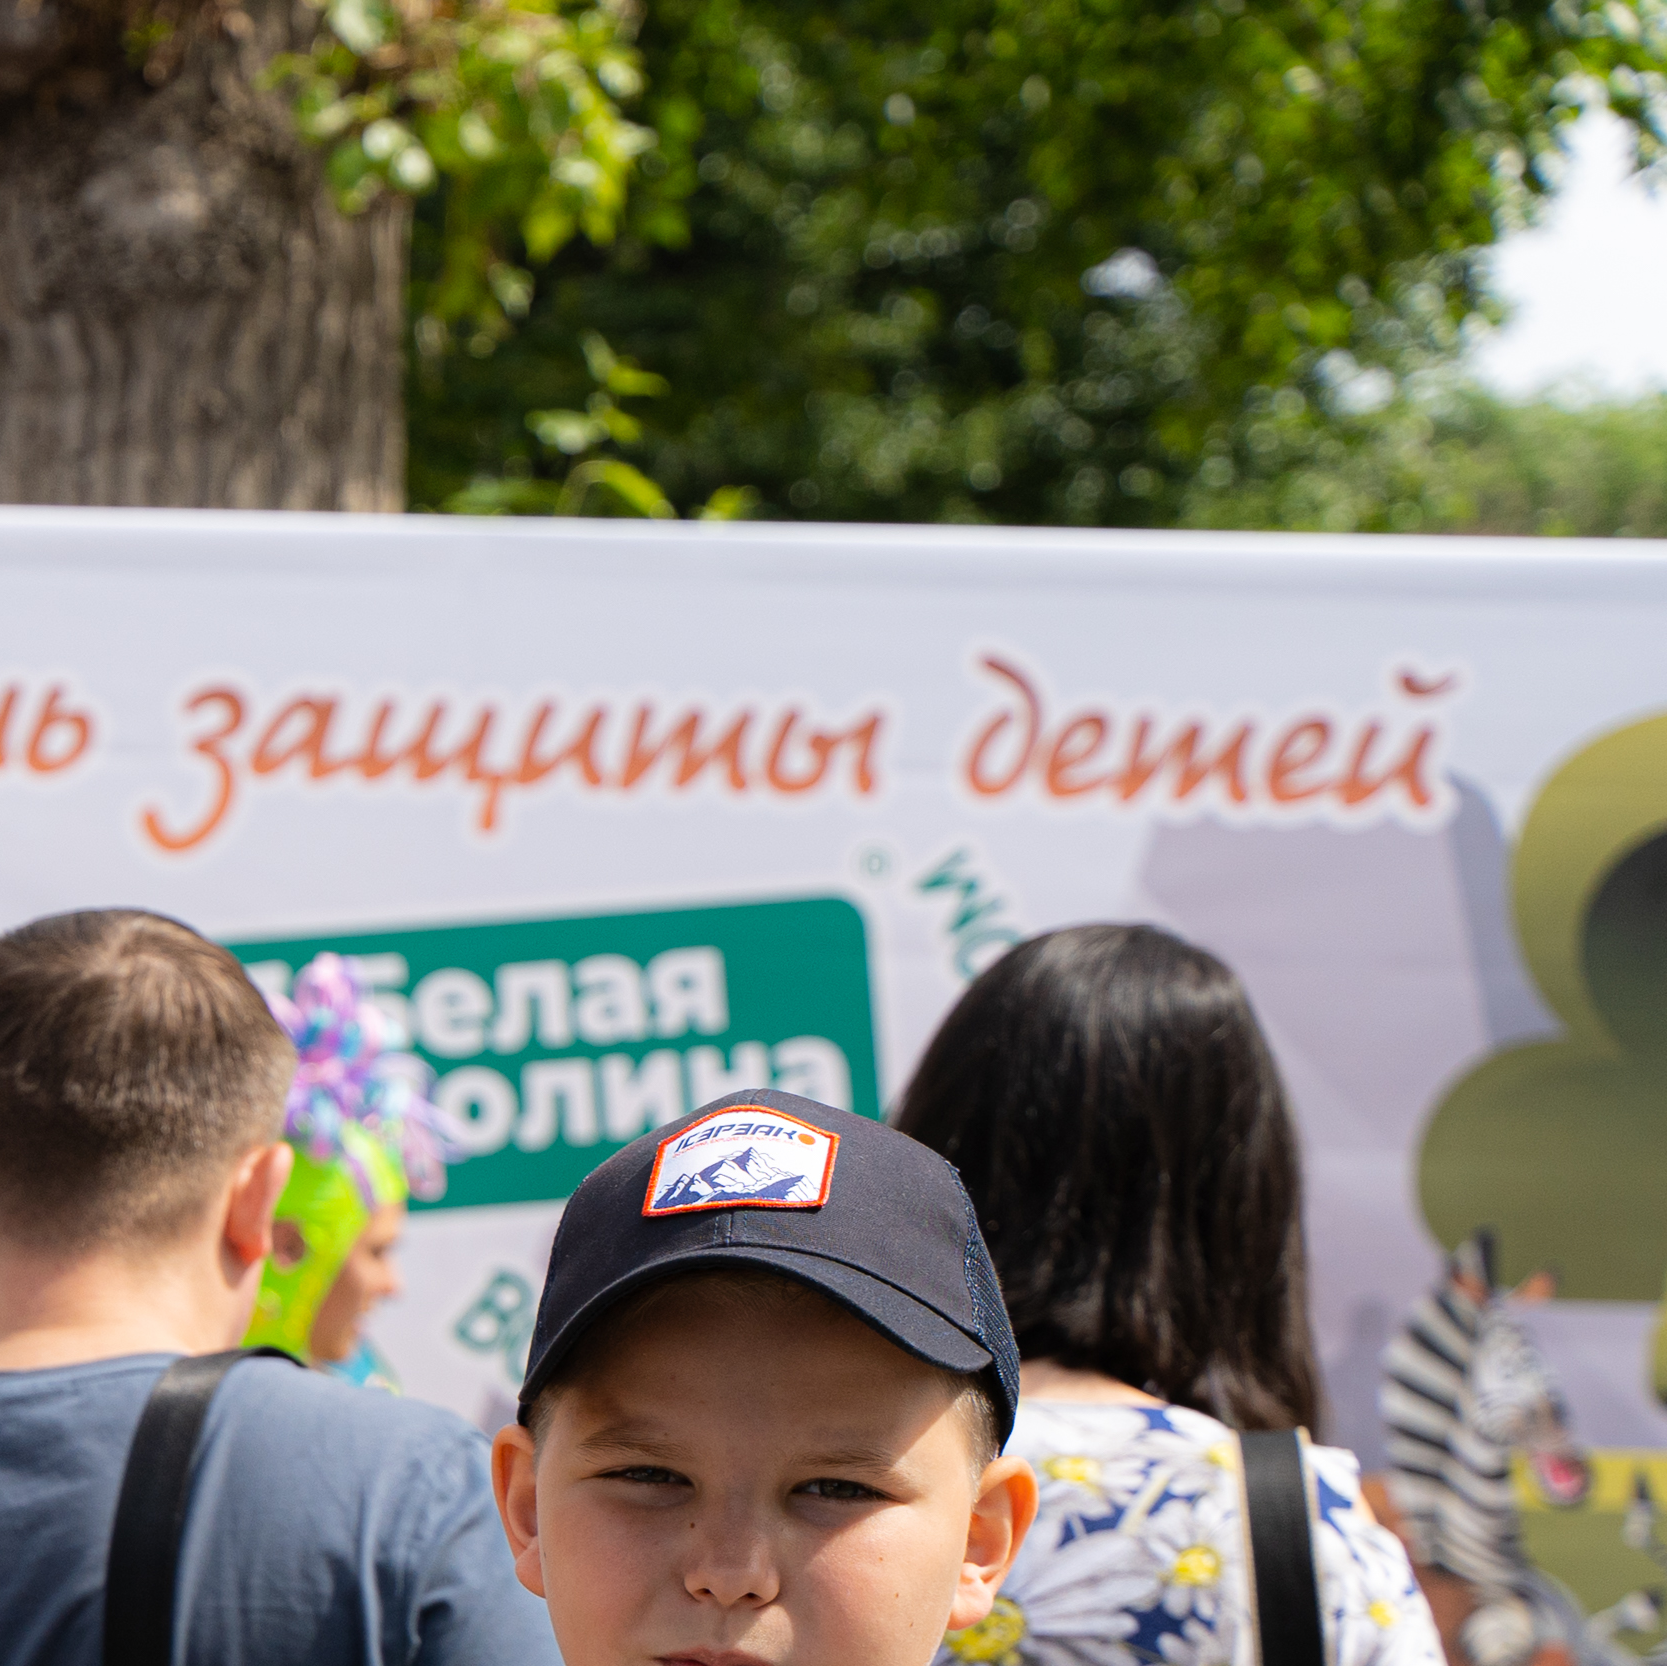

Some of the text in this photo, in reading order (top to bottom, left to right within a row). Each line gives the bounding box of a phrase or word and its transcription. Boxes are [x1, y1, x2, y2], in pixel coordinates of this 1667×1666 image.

[143, 686, 885, 853] защиты
[970, 655, 1455, 806] детей
[434, 1034, 857, 1157] олина
[675, 1122, 798, 1154] ICEPEAK
